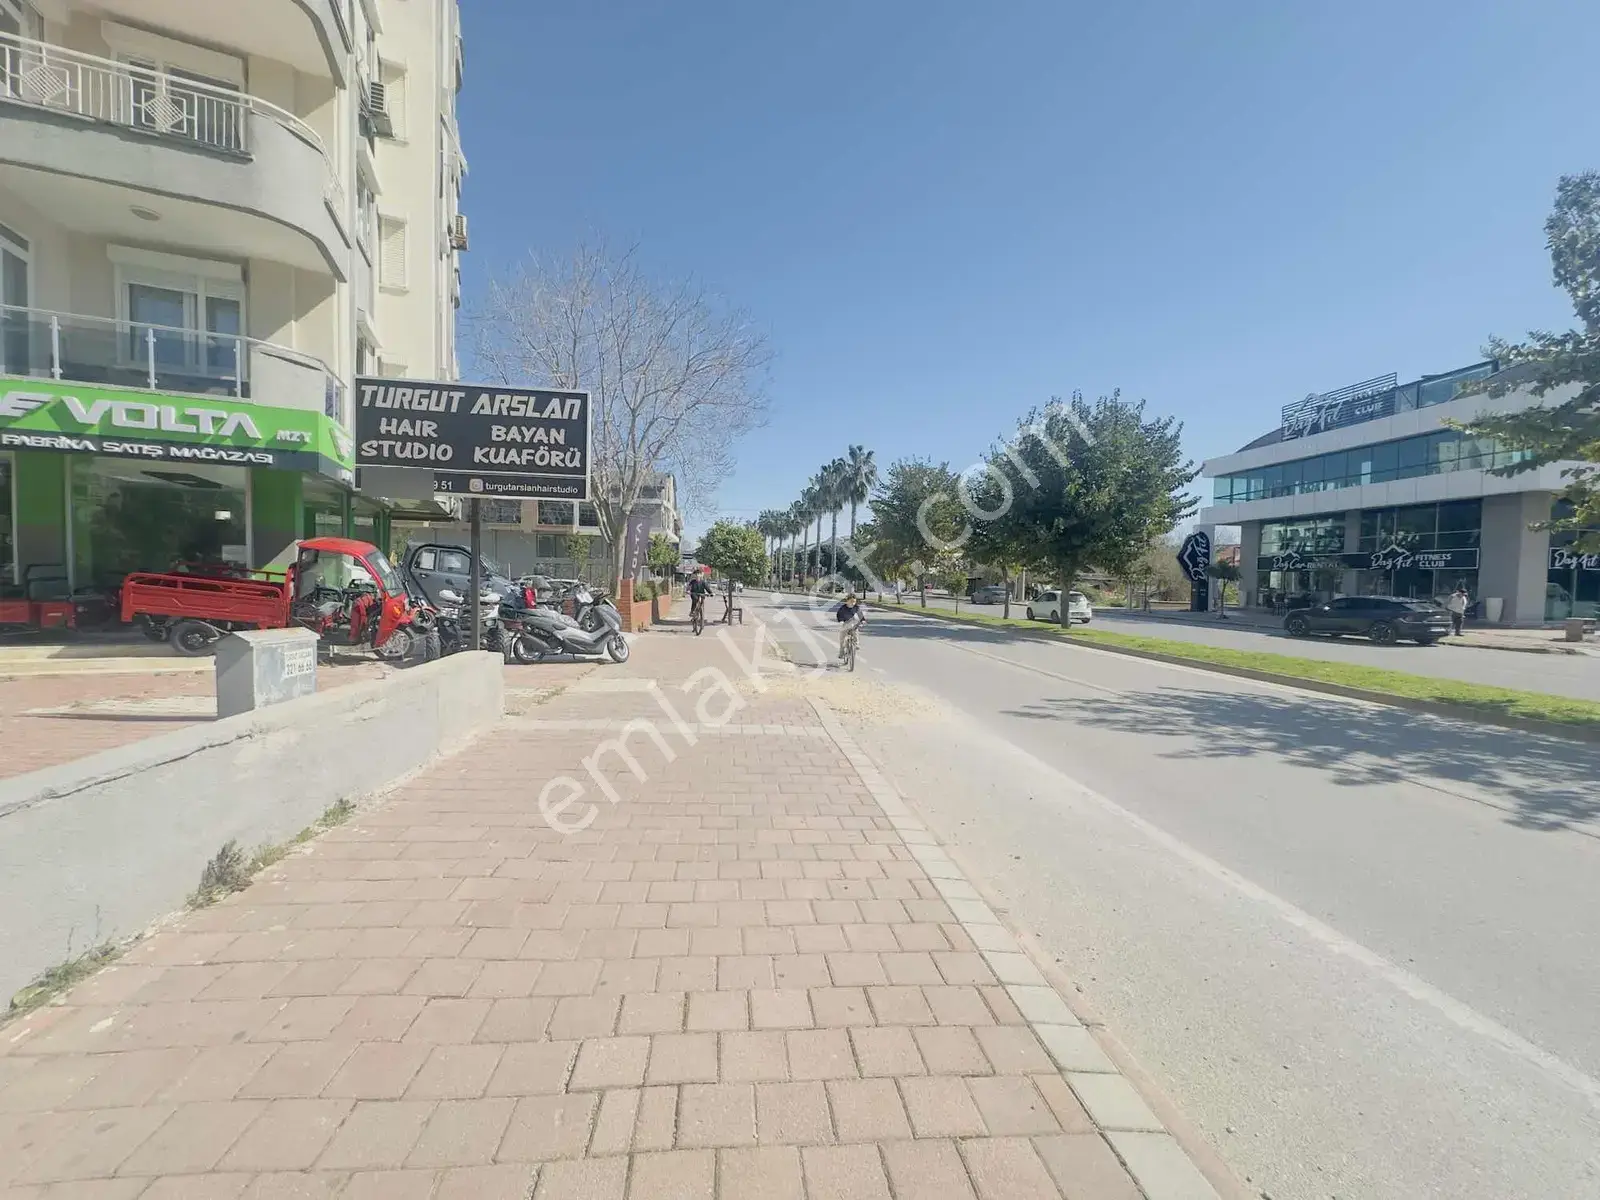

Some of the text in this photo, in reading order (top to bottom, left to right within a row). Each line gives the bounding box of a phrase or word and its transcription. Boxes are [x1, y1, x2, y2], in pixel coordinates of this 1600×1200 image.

[361, 385, 581, 420] TURGUT ARSLAN
[380, 417, 438, 438] HAIR
[491, 425, 565, 445] BAYAN
[1, 434, 273, 464] FABRİKA SATIŞ MAĞAZASI
[361, 440, 453, 461] STUDIO
[473, 446, 581, 467] KUAFÖRÜ
[441, 481, 453, 490] 51
[485, 482, 579, 494] turgutarslanhairstudio
[1415, 553, 1452, 561] FITNESS
